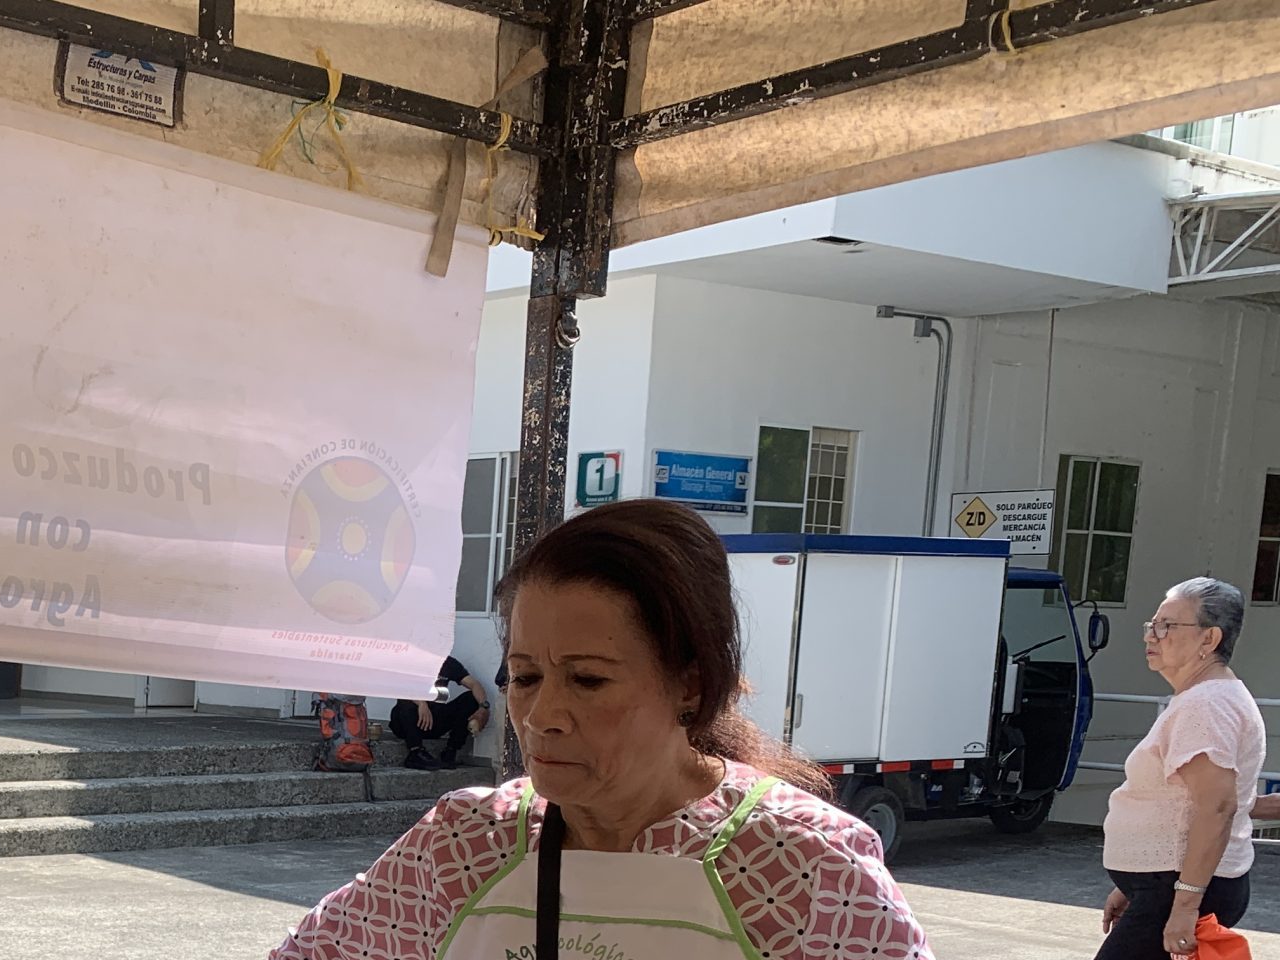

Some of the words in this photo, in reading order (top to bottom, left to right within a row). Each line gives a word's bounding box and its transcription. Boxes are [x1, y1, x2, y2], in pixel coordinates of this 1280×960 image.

[88, 57, 127, 77] Estructuras
[127, 69, 133, 80] y
[133, 69, 156, 84] Carpas
[76, 76, 90, 87] Tel:
[91, 79, 105, 90] 285
[106, 83, 115, 93] 76
[144, 92, 153, 103] 75
[122, 105, 157, 120] Colombia
[596, 464, 605, 491] 1
[705, 466, 734, 481] General
[996, 503, 1015, 511] SOLO
[1017, 502, 1053, 510] PARQUEO
[966, 512, 986, 526] Z/D
[1003, 513, 1047, 522] DESCARGUE
[1003, 523, 1046, 532] MERCANCIA
